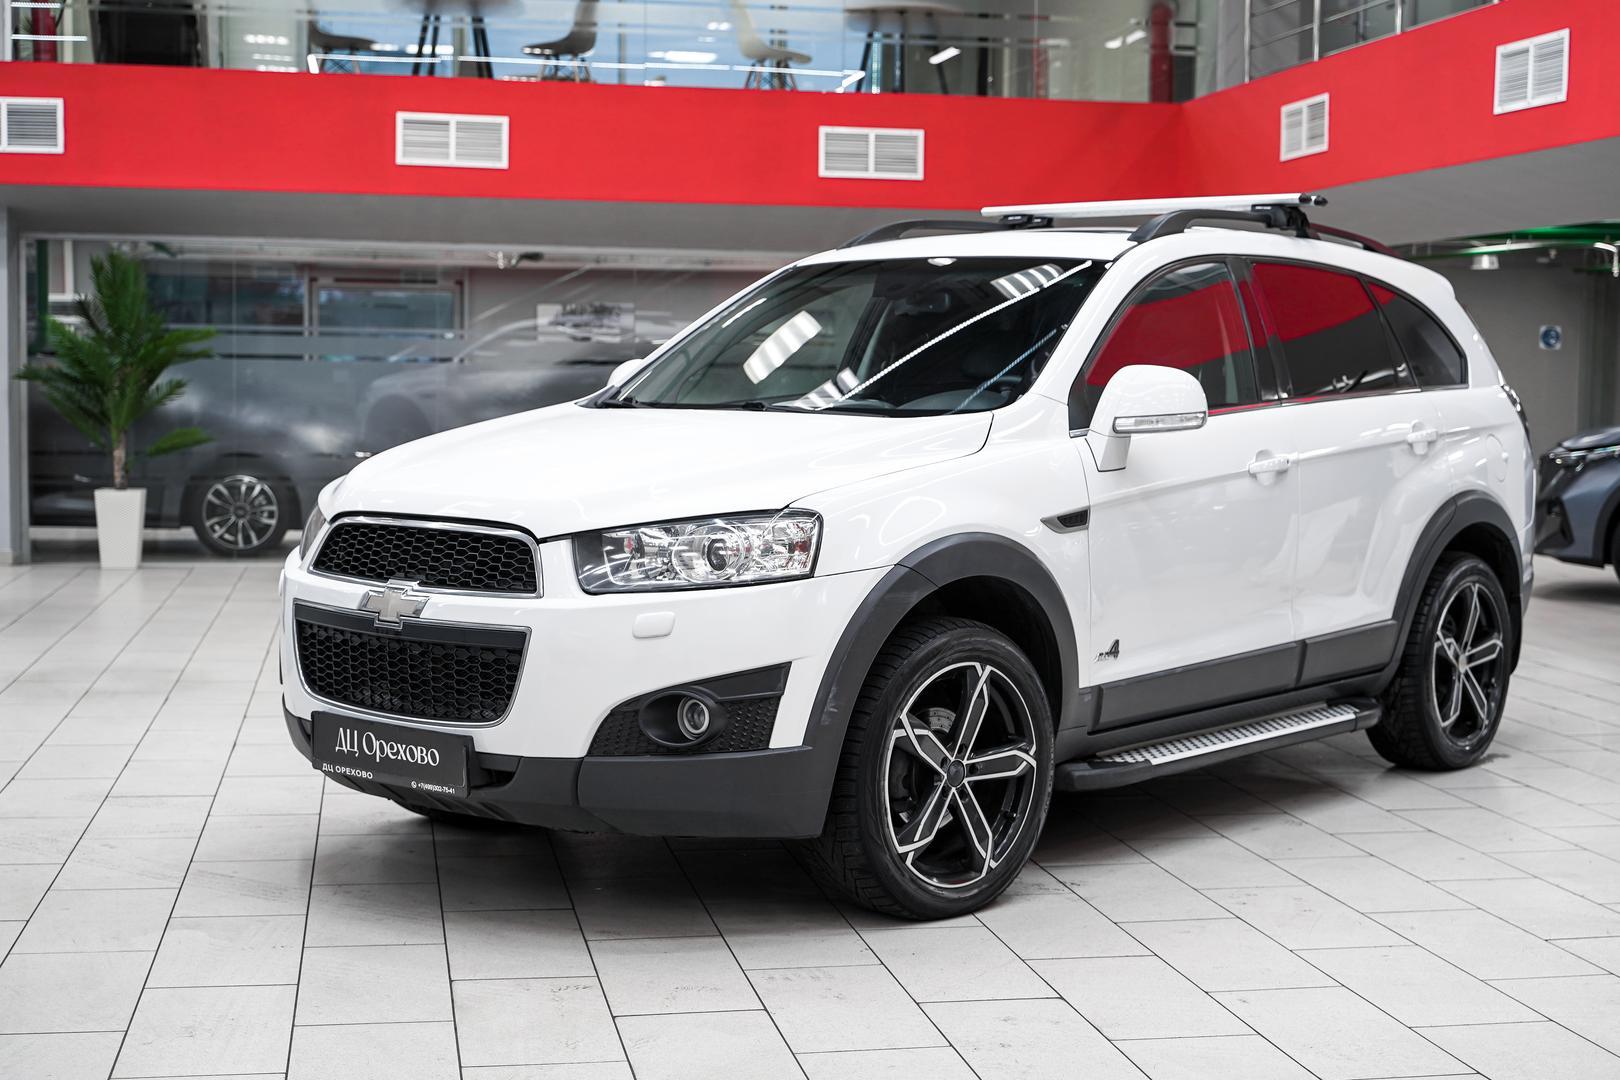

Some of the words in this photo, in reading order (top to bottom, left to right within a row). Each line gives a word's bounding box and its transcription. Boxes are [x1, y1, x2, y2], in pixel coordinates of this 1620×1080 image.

[335, 728, 359, 757] ДЦ
[362, 732, 439, 766] Орехово
[322, 763, 334, 773] ДЦ
[335, 765, 373, 779] ОРЕХОВО
